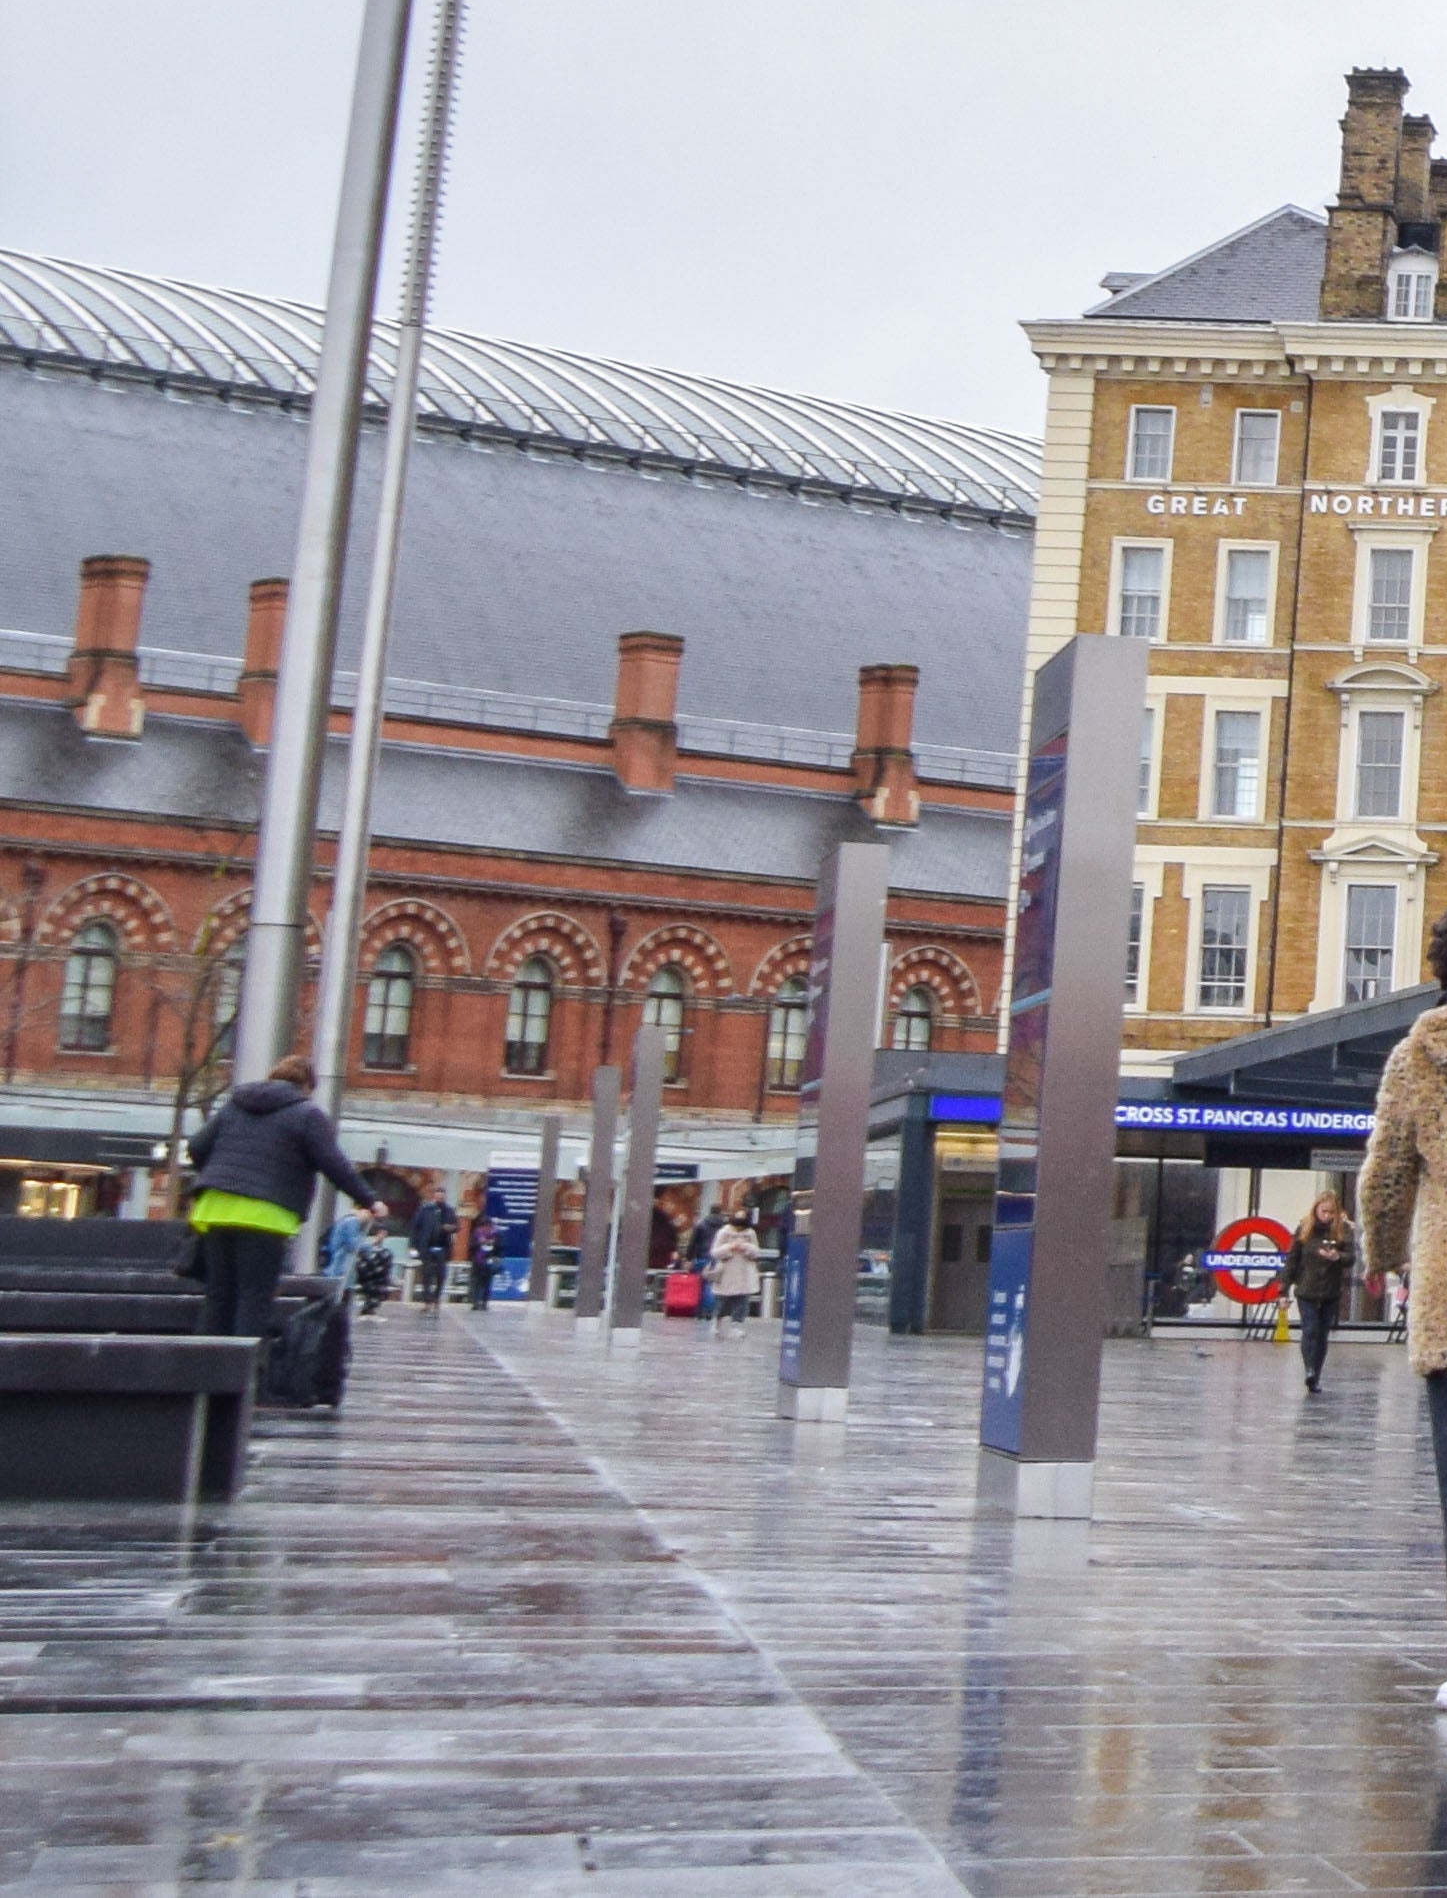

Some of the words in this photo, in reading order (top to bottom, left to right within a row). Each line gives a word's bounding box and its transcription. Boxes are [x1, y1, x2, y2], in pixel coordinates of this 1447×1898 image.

[1146, 494, 1248, 516] GREAT
[1114, 1105, 1174, 1123] CROSS
[1203, 1109, 1289, 1129] PANCRAS
[1292, 1113, 1377, 1130] UNDERGR
[1206, 1253, 1287, 1267] UNDERGROU
